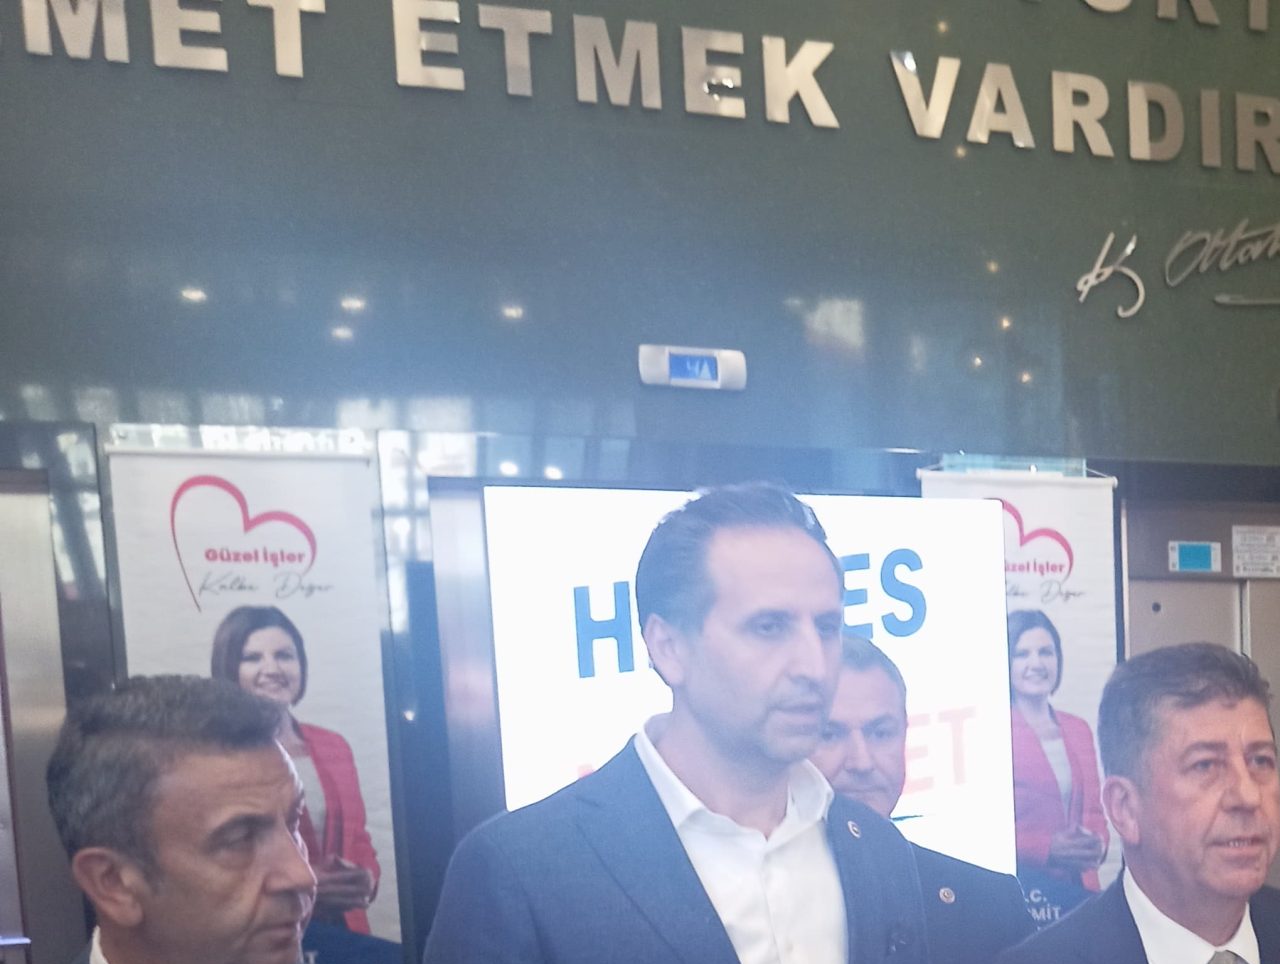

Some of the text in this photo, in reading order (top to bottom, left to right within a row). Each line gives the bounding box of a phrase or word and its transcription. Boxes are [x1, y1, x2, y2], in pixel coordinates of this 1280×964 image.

[393, 0, 841, 129] ETMEK
[204, 546, 306, 568] Güzel İşler
